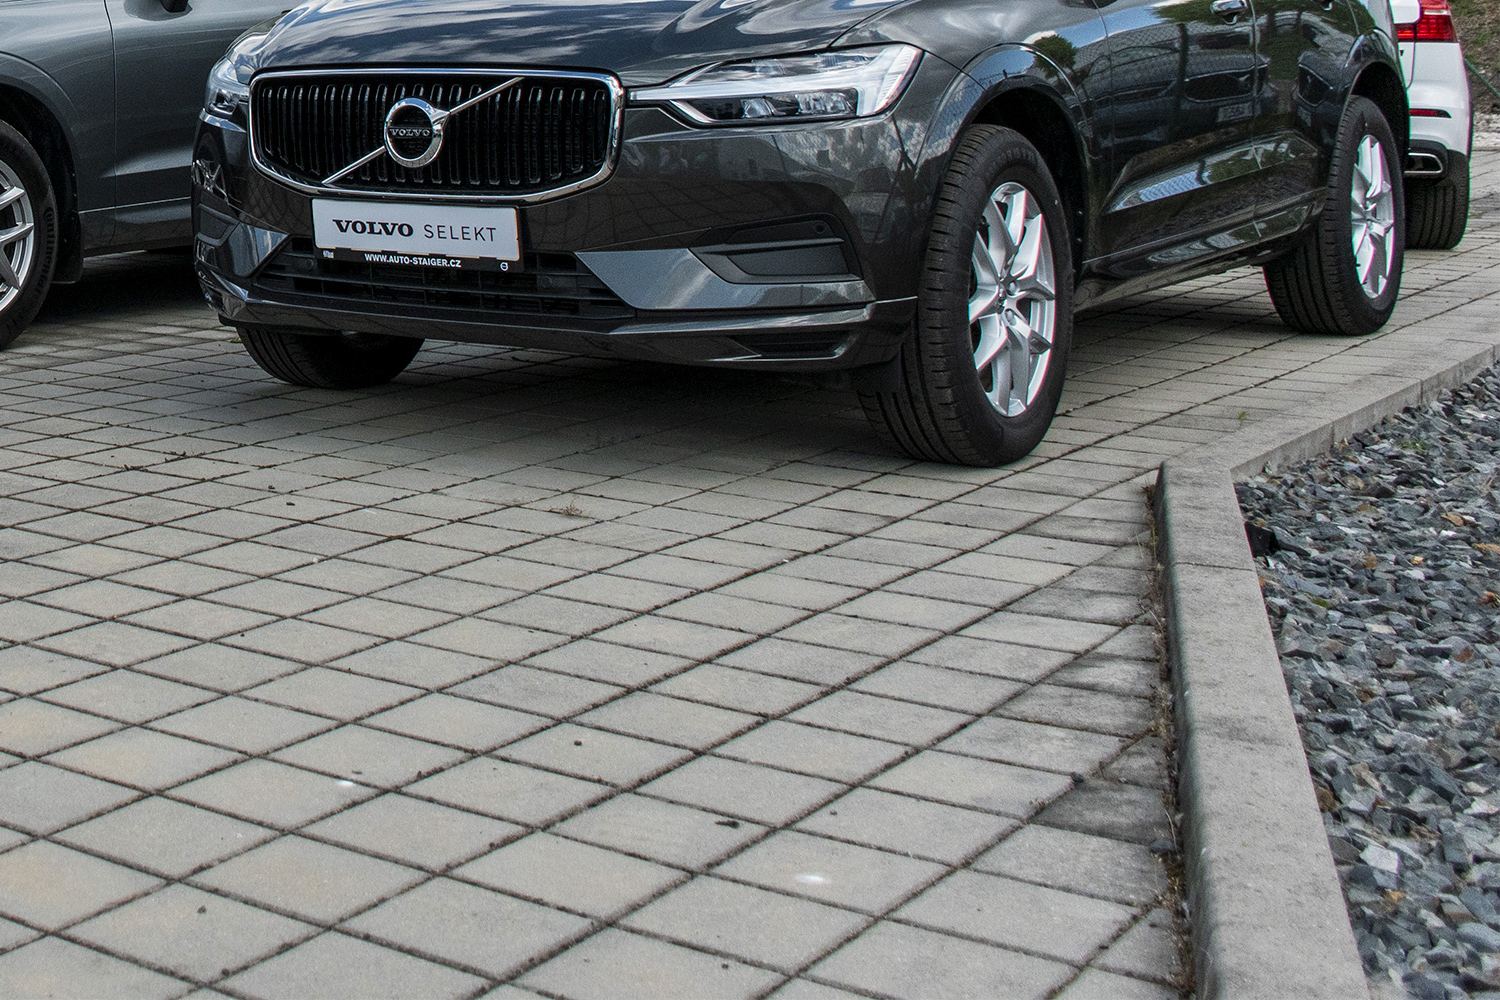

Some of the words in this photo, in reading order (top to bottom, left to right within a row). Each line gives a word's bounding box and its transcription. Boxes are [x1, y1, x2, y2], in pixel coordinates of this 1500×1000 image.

[389, 128, 431, 137] VOLVO
[332, 219, 414, 238] VOLVO
[424, 224, 497, 242] SELEKT
[364, 253, 462, 268] WWW.AUTO-STAIGER.CZ
